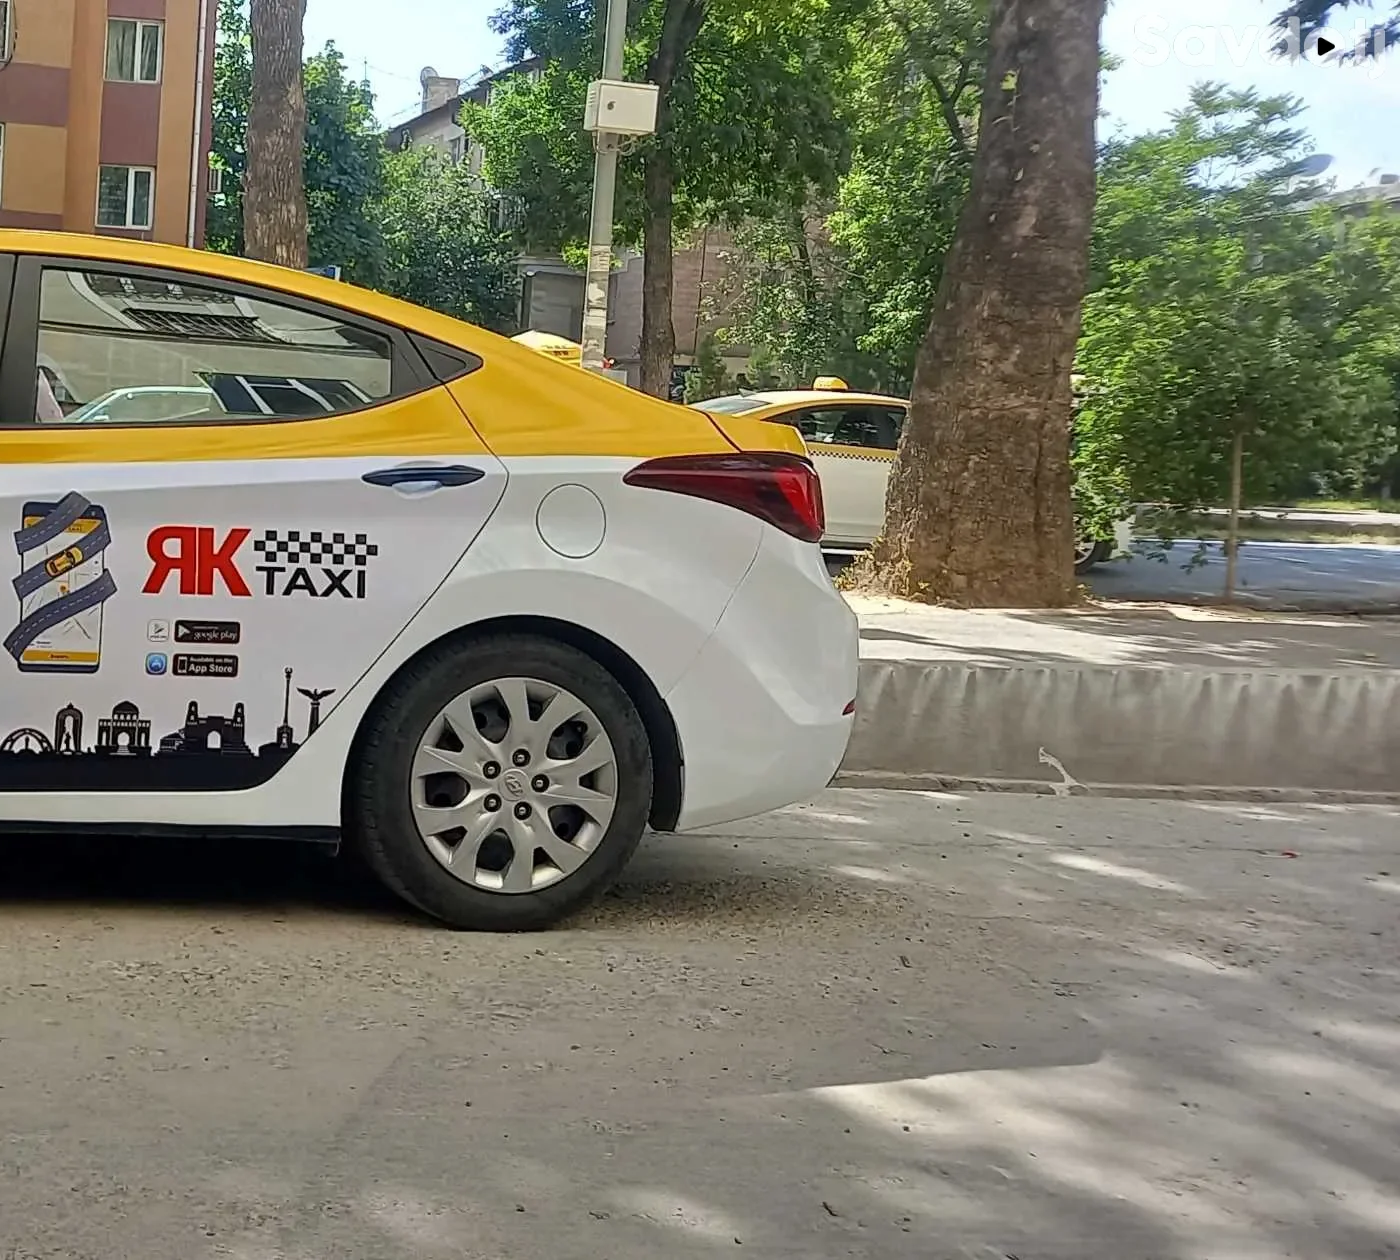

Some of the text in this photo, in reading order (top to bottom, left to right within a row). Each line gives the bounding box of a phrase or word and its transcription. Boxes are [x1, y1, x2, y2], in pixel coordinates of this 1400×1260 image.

[255, 565, 367, 599] TAXI
[189, 664, 233, 674] App Store
